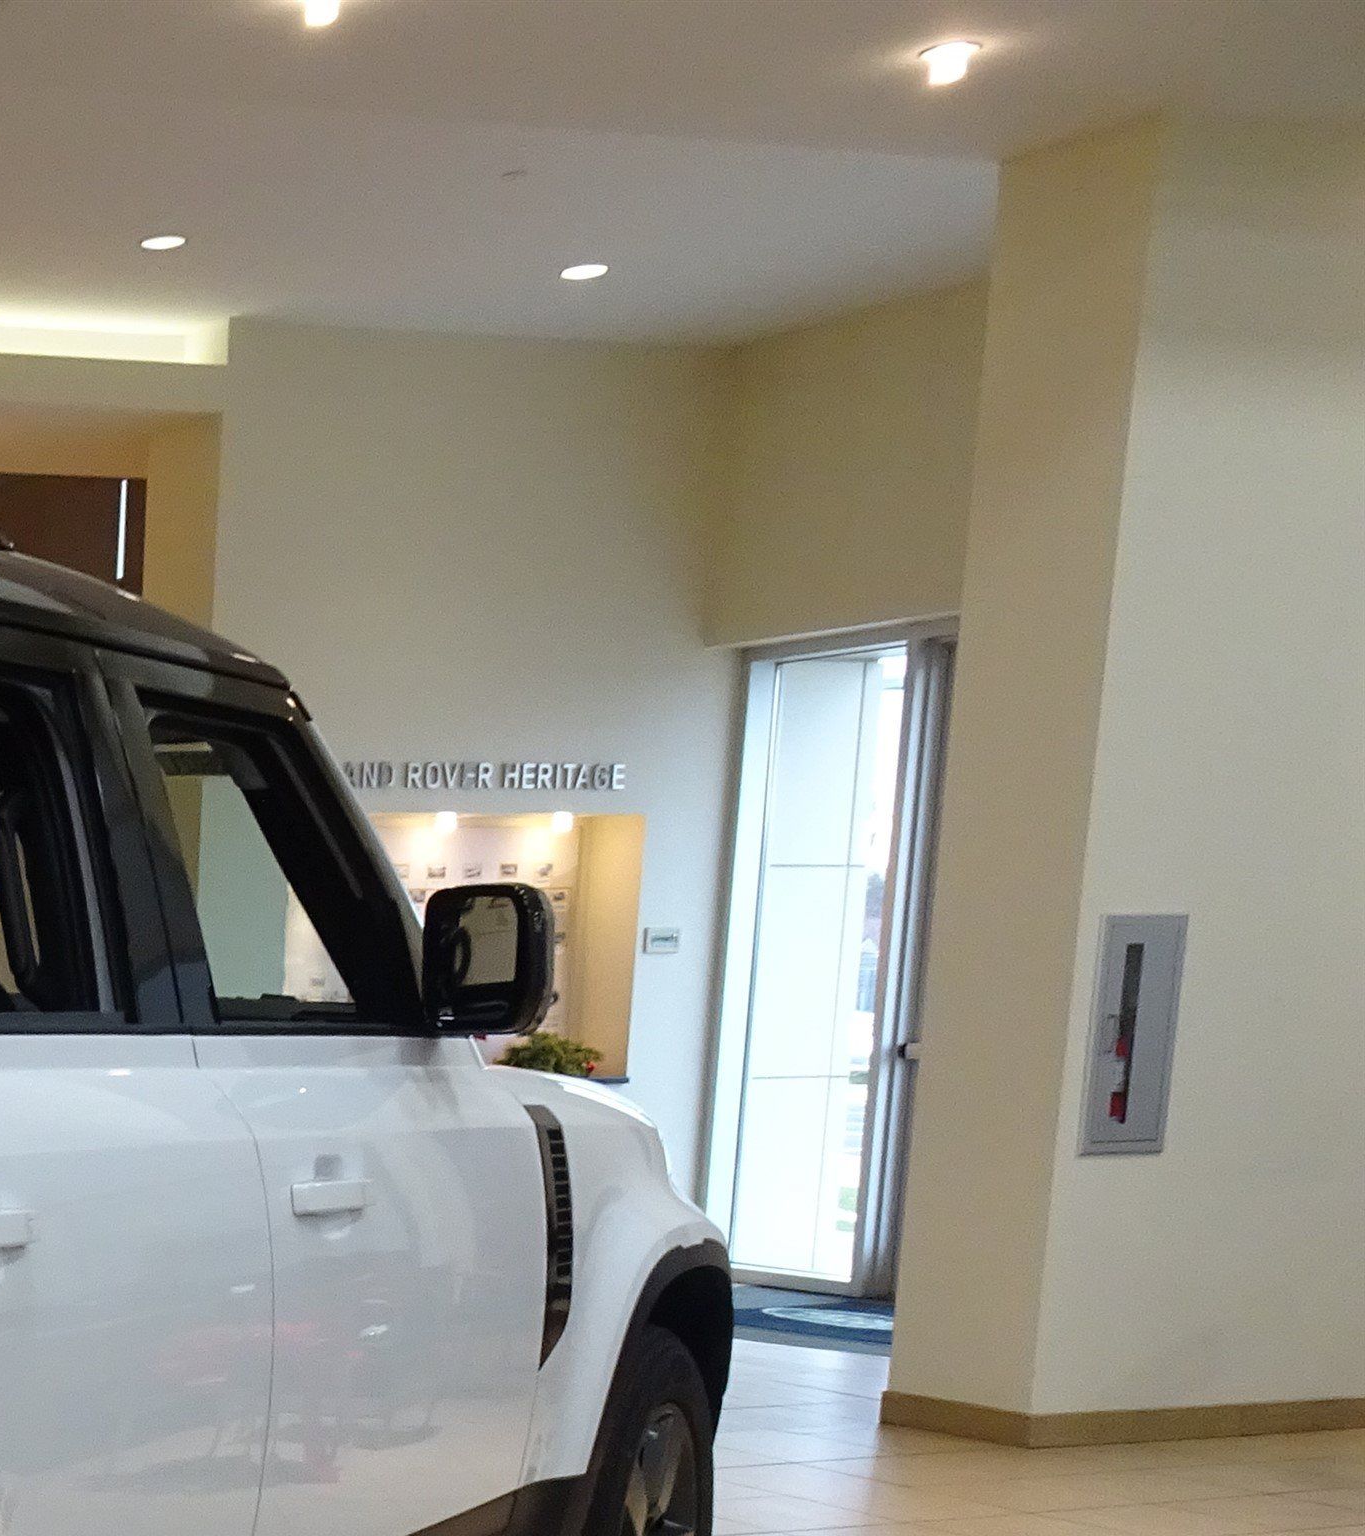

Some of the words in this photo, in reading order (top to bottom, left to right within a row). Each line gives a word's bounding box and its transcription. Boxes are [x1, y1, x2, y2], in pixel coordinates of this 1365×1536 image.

[342, 761, 395, 789] AND
[404, 761, 494, 789] ROVER
[501, 761, 627, 790] HERITAGE
